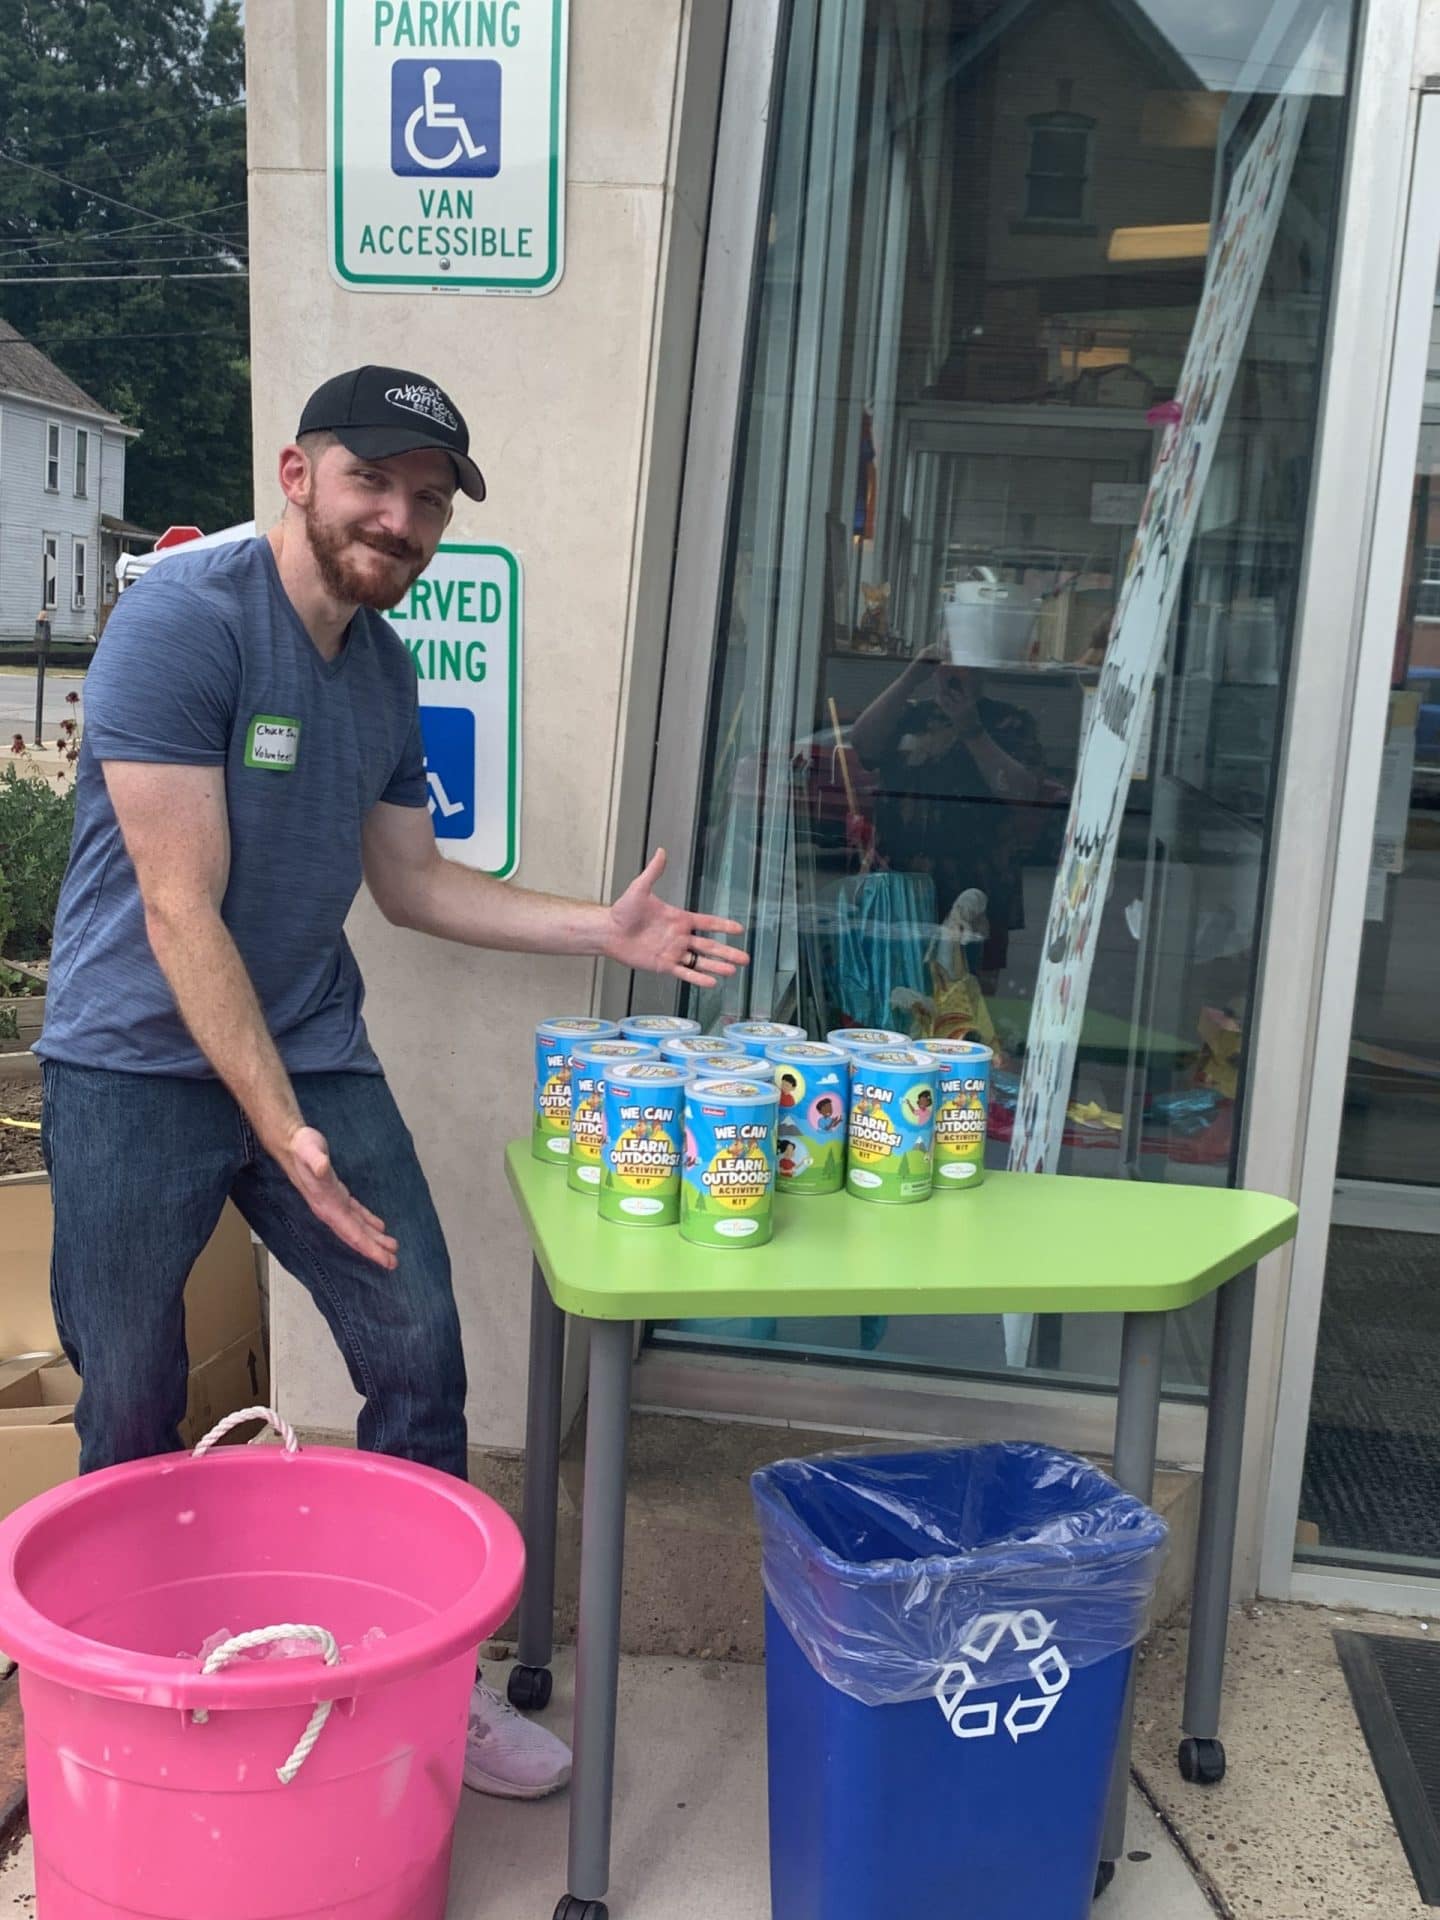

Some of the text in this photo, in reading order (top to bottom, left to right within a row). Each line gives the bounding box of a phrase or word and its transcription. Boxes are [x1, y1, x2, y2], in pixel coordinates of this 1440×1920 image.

[374, 0, 521, 47] PARKING
[418, 189, 473, 219] VAN
[359, 225, 533, 257] ACCESSIBLE
[389, 579, 502, 623] RVED
[547, 1055, 564, 1067] WE
[942, 1079, 985, 1092] WE CAN
[866, 1085, 893, 1103] CAN
[620, 1106, 673, 1121] WE CAN
[943, 1109, 982, 1121] LEARN
[852, 1113, 888, 1132] LEARN
[714, 1125, 768, 1139] WE CAN
[622, 1140, 668, 1153] LEARN
[610, 1152, 681, 1166] OUTDOORS!
[717, 1159, 763, 1172] LEARN
[624, 1165, 665, 1175] ACTIVITY
